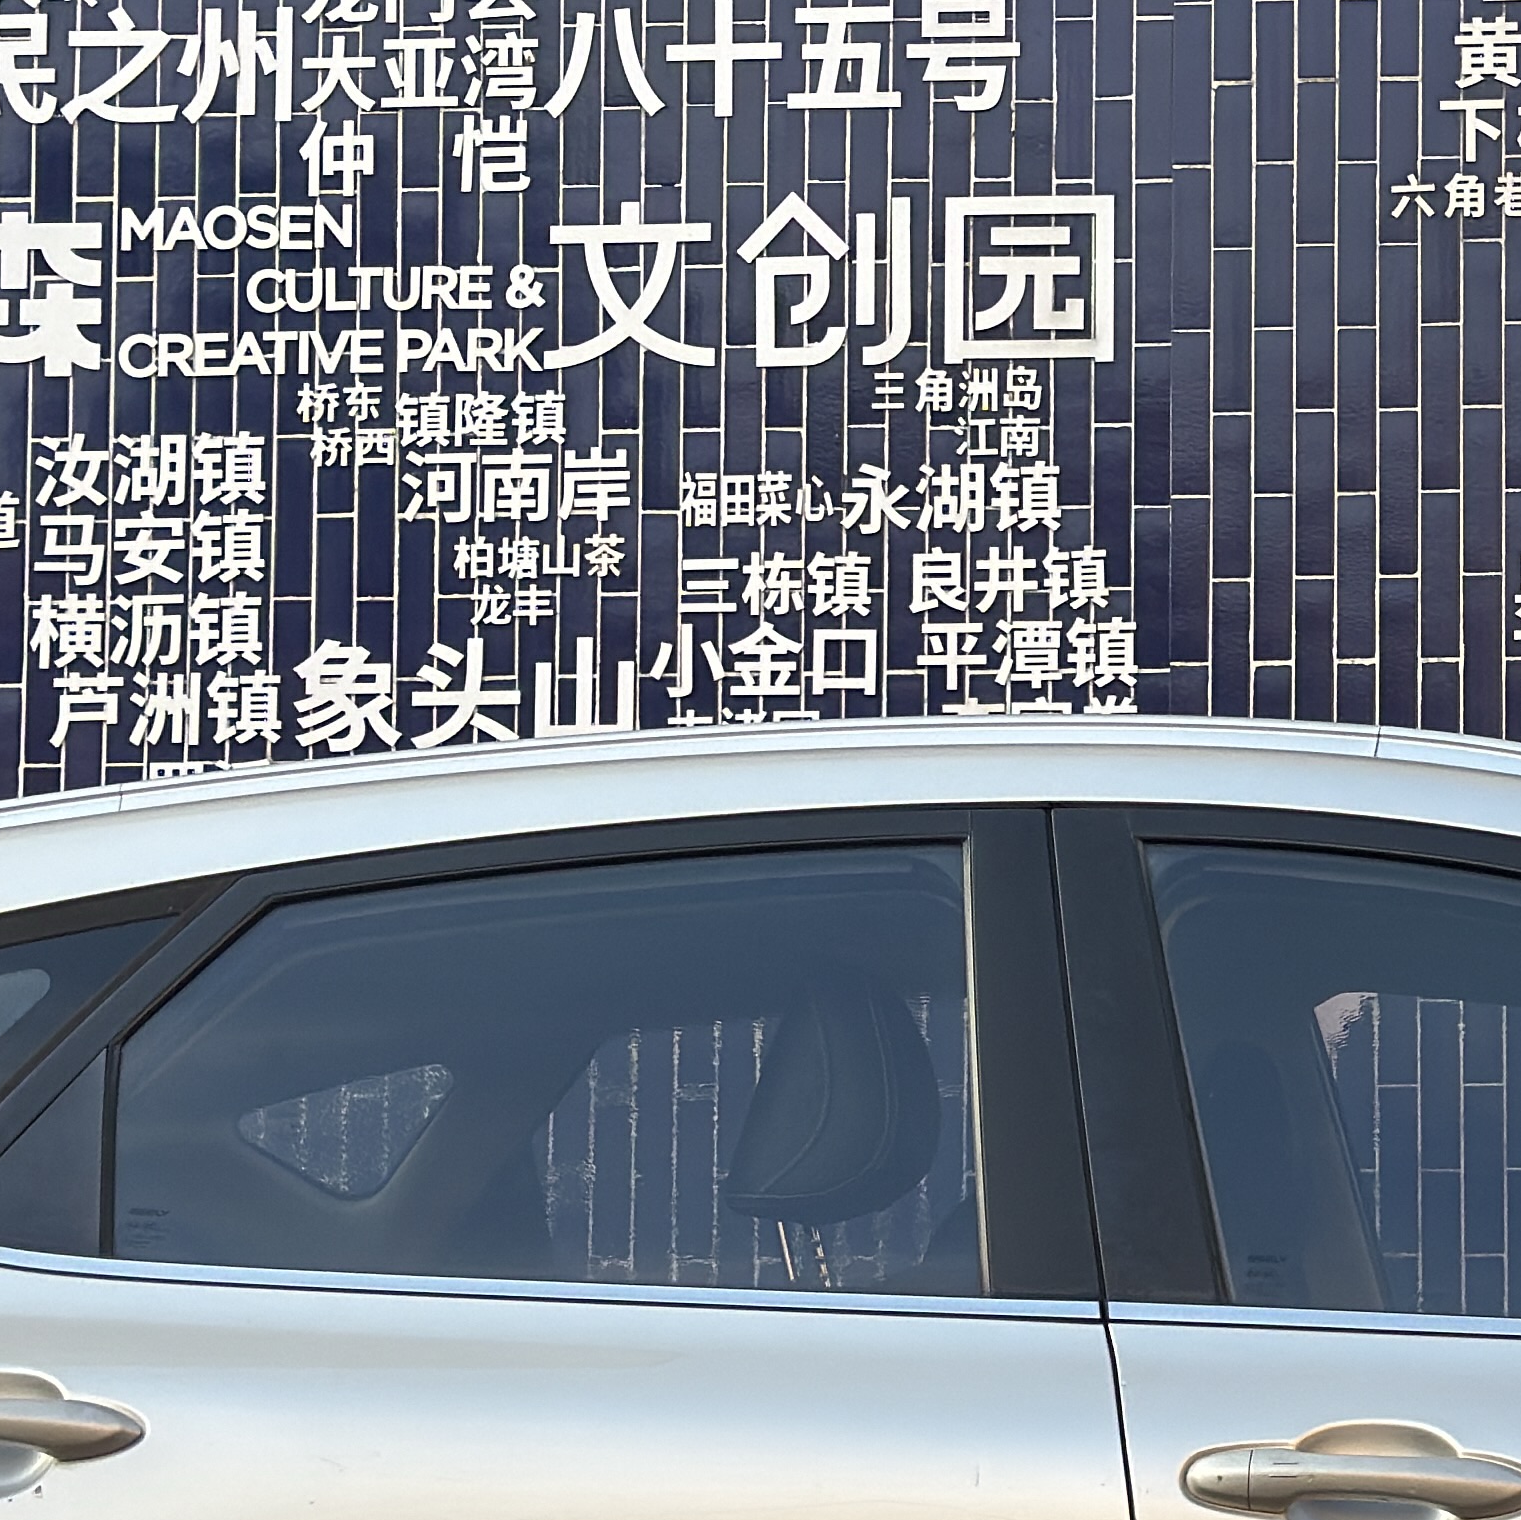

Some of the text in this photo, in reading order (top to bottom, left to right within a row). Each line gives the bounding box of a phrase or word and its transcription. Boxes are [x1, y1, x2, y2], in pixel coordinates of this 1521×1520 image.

[301, 33, 538, 114] 大亚湾
[299, 115, 530, 197] 仲恺
[120, 204, 352, 251] MAOSEN
[246, 264, 544, 314] CULTURE &
[543, 191, 1115, 368] 文创园
[119, 327, 544, 377] CREATIVE PARK
[297, 382, 382, 424] 桥东
[396, 390, 566, 447] 镇隆镇
[872, 366, 1043, 412] 三角洲岛
[34, 431, 266, 508] 汝湖镇
[310, 427, 396, 467] 桥西
[956, 416, 1041, 457] 江南
[401, 446, 631, 523] 河南岸
[681, 471, 834, 528] 福田菜心
[842, 460, 1062, 535] 永湖镇
[32, 508, 265, 587] 马安镇
[453, 533, 626, 579] 柏塘山茶
[681, 545, 1109, 617] 三栋镇 良井镇
[31, 591, 263, 669] 横沥镇
[470, 584, 555, 626] 龙丰
[652, 617, 1138, 698] 小金口 平潭镇
[50, 669, 282, 748] 芦洲镇
[293, 636, 634, 754] 象头山
